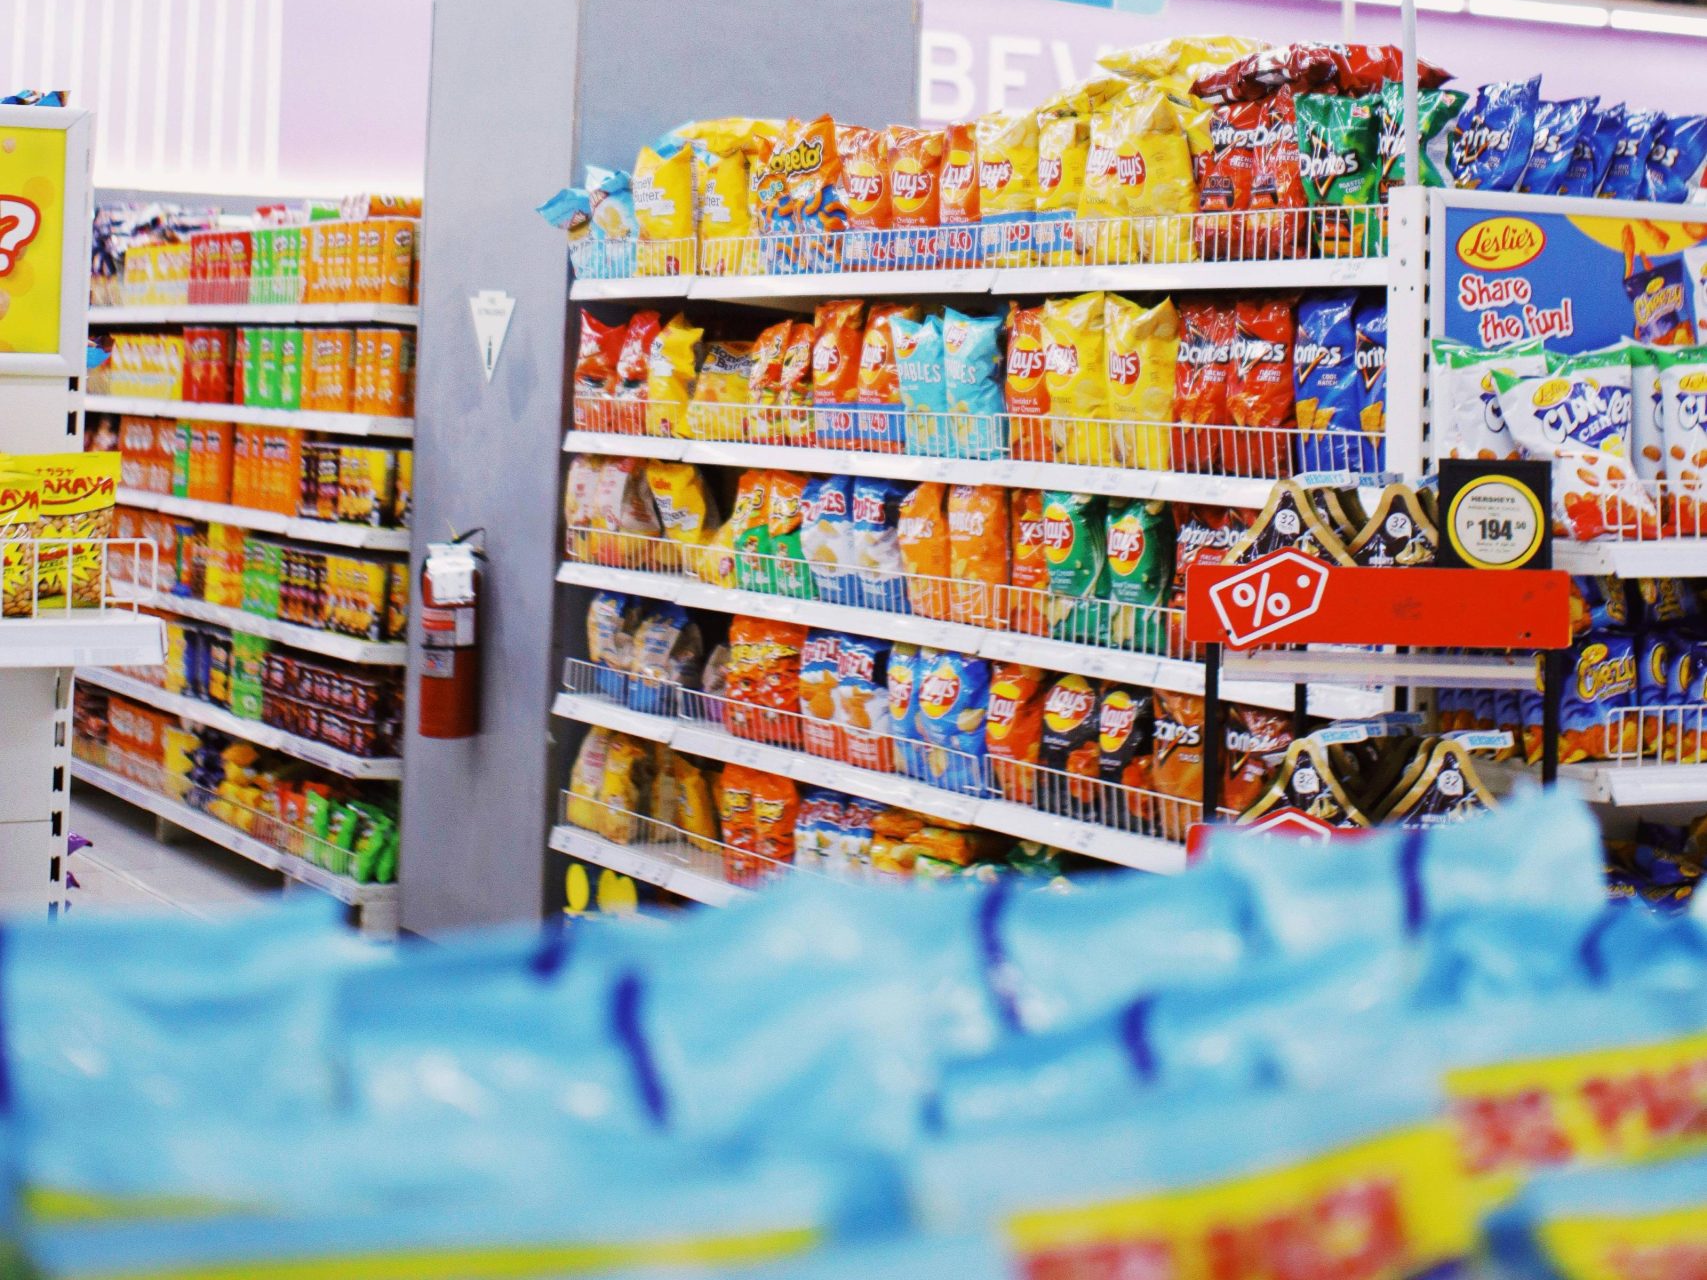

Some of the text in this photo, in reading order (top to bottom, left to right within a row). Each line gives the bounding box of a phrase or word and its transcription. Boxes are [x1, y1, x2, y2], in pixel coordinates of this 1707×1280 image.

[1117, 155, 1142, 187] Lay's
[1299, 151, 1359, 178] Doritos
[891, 170, 928, 200] Lay's
[1463, 224, 1537, 261] Leslie's
[1460, 274, 1530, 307] Share
[1480, 299, 1572, 345] the fun!
[1007, 347, 1044, 379] Lay's
[1109, 351, 1137, 385] Lay's
[1355, 346, 1386, 370] orit
[1044, 518, 1070, 549] Lay's
[1281, 512, 1296, 526] 32
[1391, 517, 1407, 530] 32
[1478, 519, 1513, 540] 194
[1108, 527, 1141, 562] Lay's
[920, 676, 957, 705] Lay's
[1045, 686, 1088, 719] Lay's
